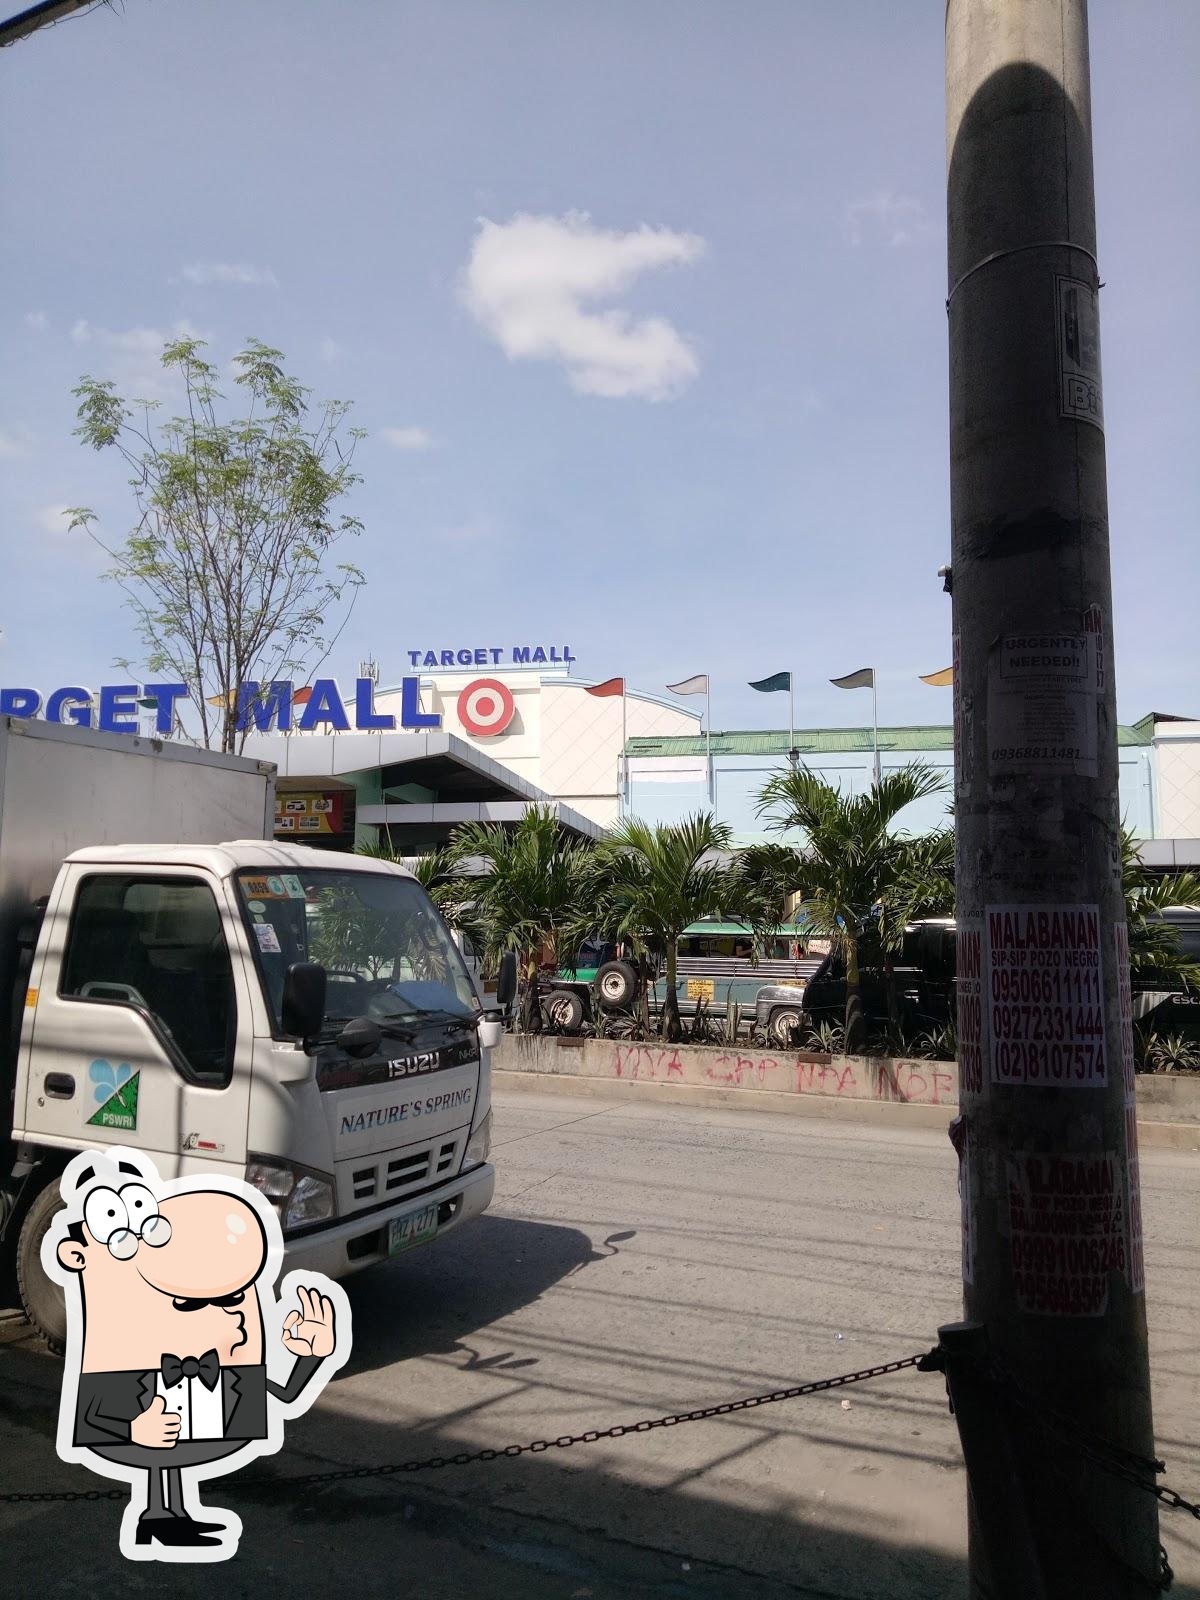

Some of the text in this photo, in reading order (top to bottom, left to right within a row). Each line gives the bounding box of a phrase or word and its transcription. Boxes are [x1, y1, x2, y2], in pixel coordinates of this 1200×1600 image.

[408, 646, 576, 666] TARGET MALL
[1009, 655, 1080, 668] NEEDED!!
[236, 677, 443, 731] MALL
[989, 911, 1099, 950] MALABANAN
[991, 951, 1099, 967] SIP-SIP POZO NEGRO
[991, 968, 1100, 1003] 09506611111
[1172, 996, 1200, 1005] ESC
[993, 1005, 1104, 1041] 09272331444
[388, 1051, 440, 1078] ISUZU
[995, 1042, 1106, 1082] (02)8107574
[102, 1113, 133, 1128] PSWRI
[340, 1088, 472, 1135] NATURE'S SPRING
